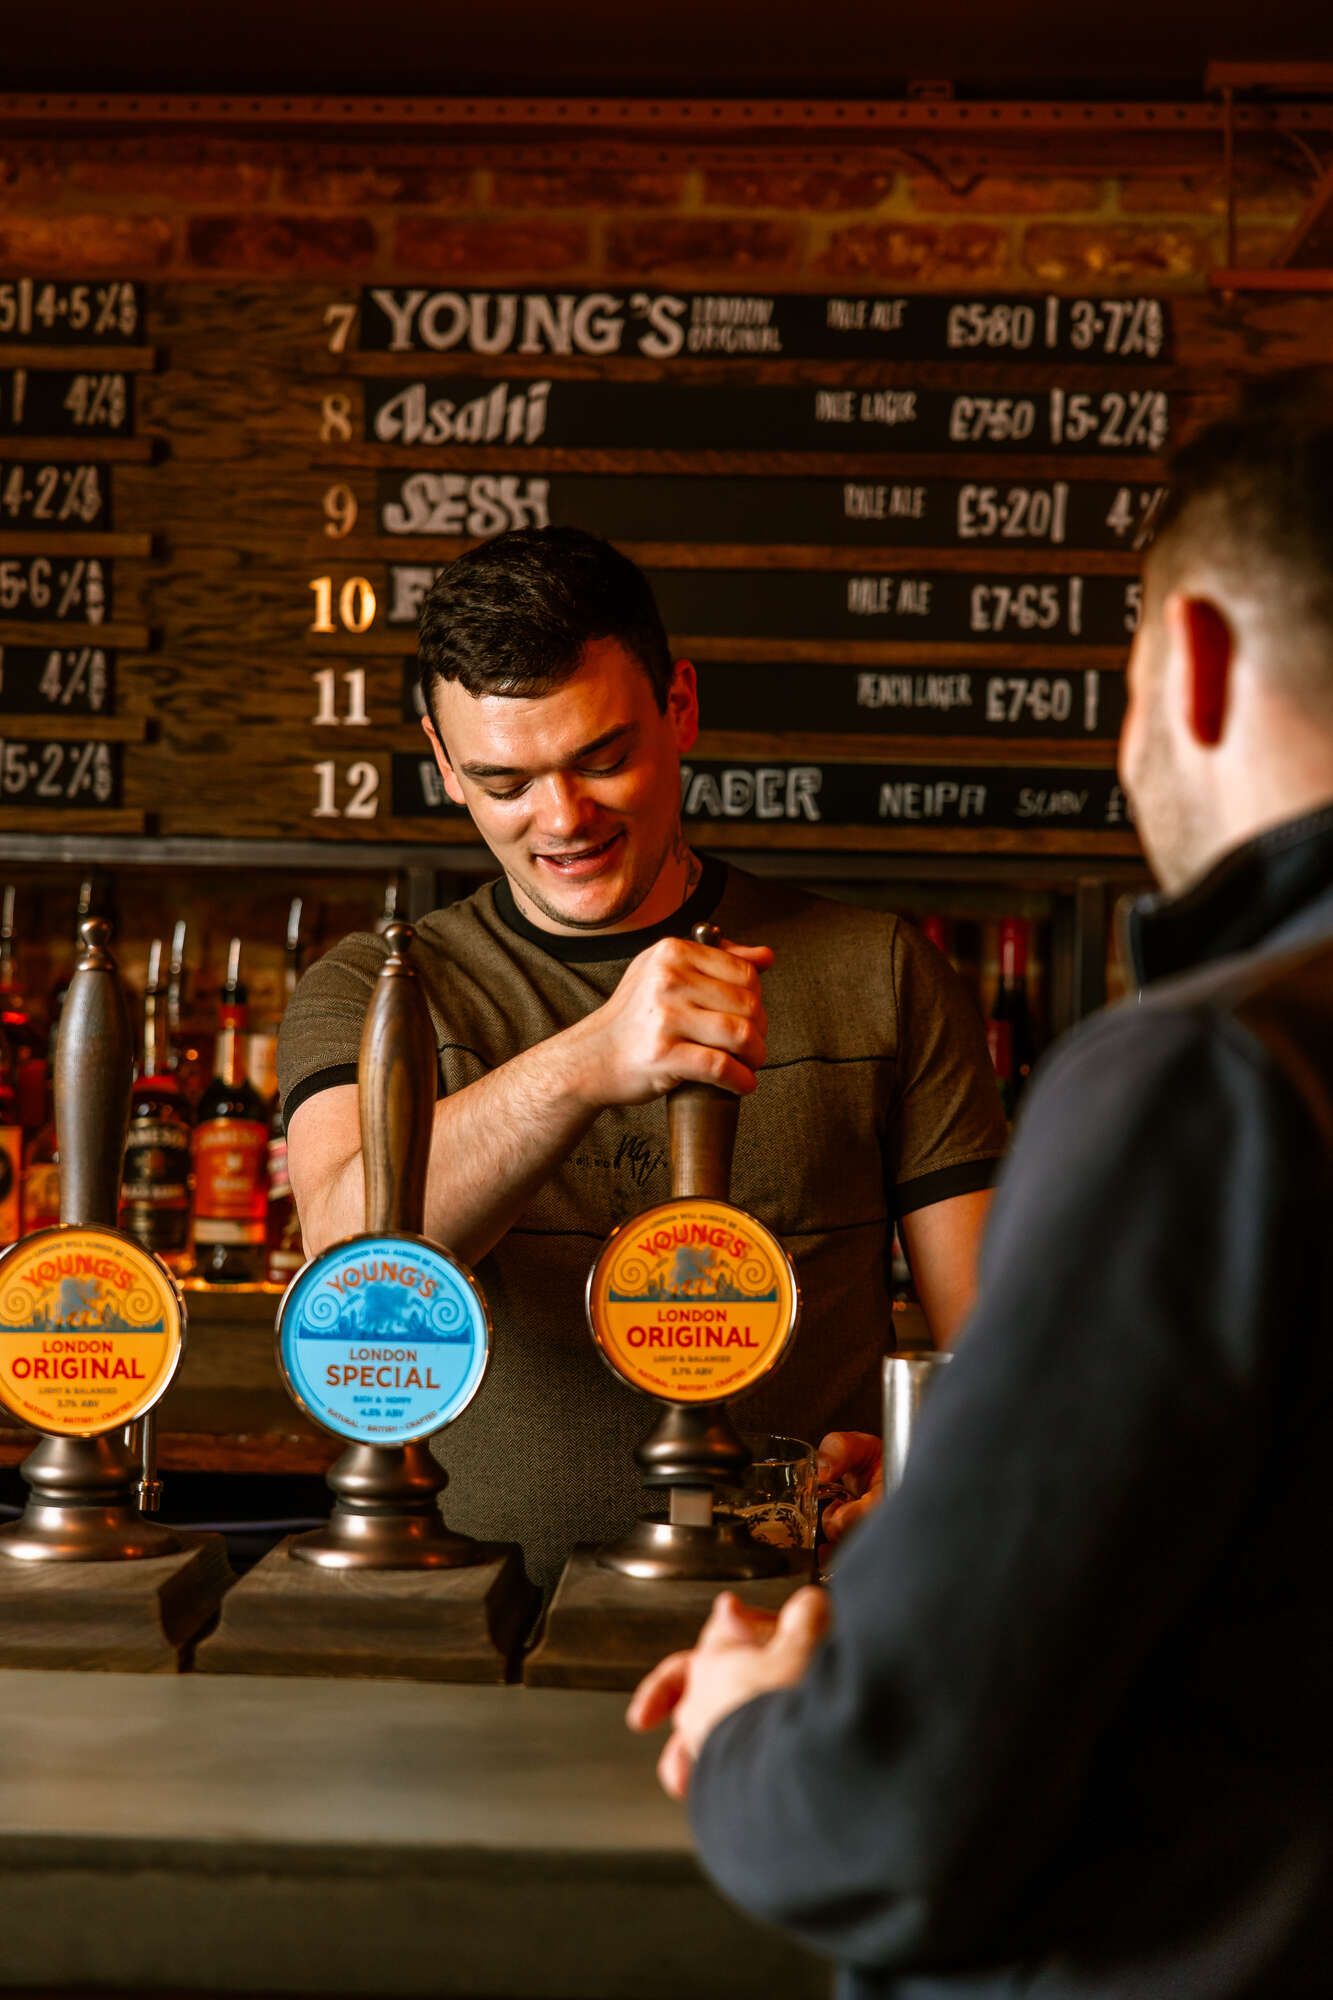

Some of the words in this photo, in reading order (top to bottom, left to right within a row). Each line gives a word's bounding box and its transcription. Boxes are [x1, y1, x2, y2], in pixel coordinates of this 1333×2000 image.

[322, 303, 357, 353] 7
[371, 289, 687, 358] YOUNG'S
[320, 394, 352, 443] 8
[375, 380, 552, 445] Asahi
[322, 484, 358, 538] 9
[383, 472, 550, 538] SESH
[308, 576, 376, 634] 10
[311, 668, 372, 726] 11
[312, 761, 380, 818] 12
[878, 780, 988, 820] NEIPA
[638, 1224, 747, 1258] YOUNG'S
[21, 1253, 135, 1289] YOUNG'S
[326, 1260, 440, 1299] YOUNG'S
[657, 1309, 728, 1322] LONDON
[43, 1340, 113, 1353] LONDON
[349, 1347, 418, 1361] LONDON
[626, 1326, 759, 1348] ORIGINAL
[11, 1357, 146, 1379] ORIGINAL
[326, 1364, 440, 1389] SPECIAL
